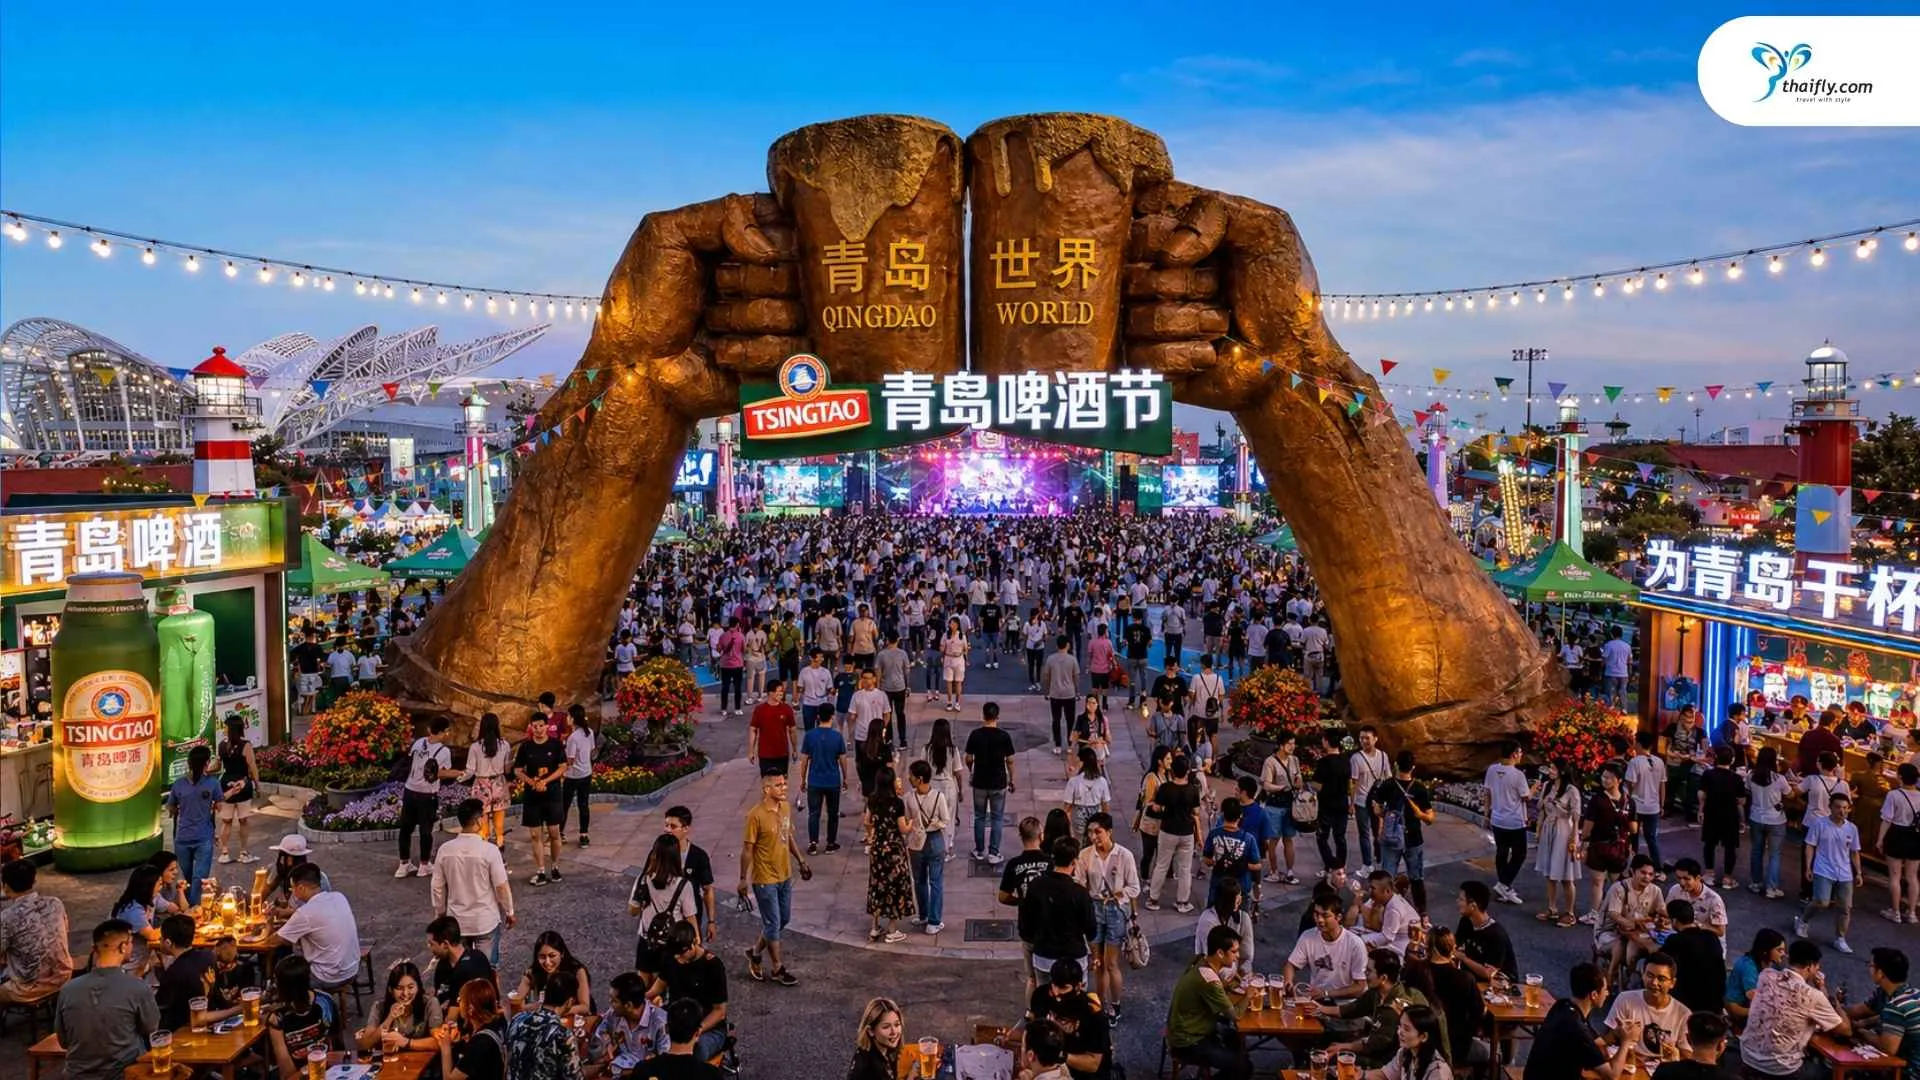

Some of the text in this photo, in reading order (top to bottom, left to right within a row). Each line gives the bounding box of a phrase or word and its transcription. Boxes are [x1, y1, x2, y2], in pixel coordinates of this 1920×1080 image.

[821, 237, 931, 294] 青岛
[989, 237, 1101, 291] 世界
[822, 304, 937, 332] QINGDAO
[996, 301, 1095, 326] WORLD
[751, 398, 860, 431] TSINGTAO
[880, 368, 1164, 431] 青岛啤酒节
[11, 512, 222, 585] 青岛啤酒
[1644, 539, 1920, 632] 为青岛干杯
[66, 719, 153, 743] TSINGTAO
